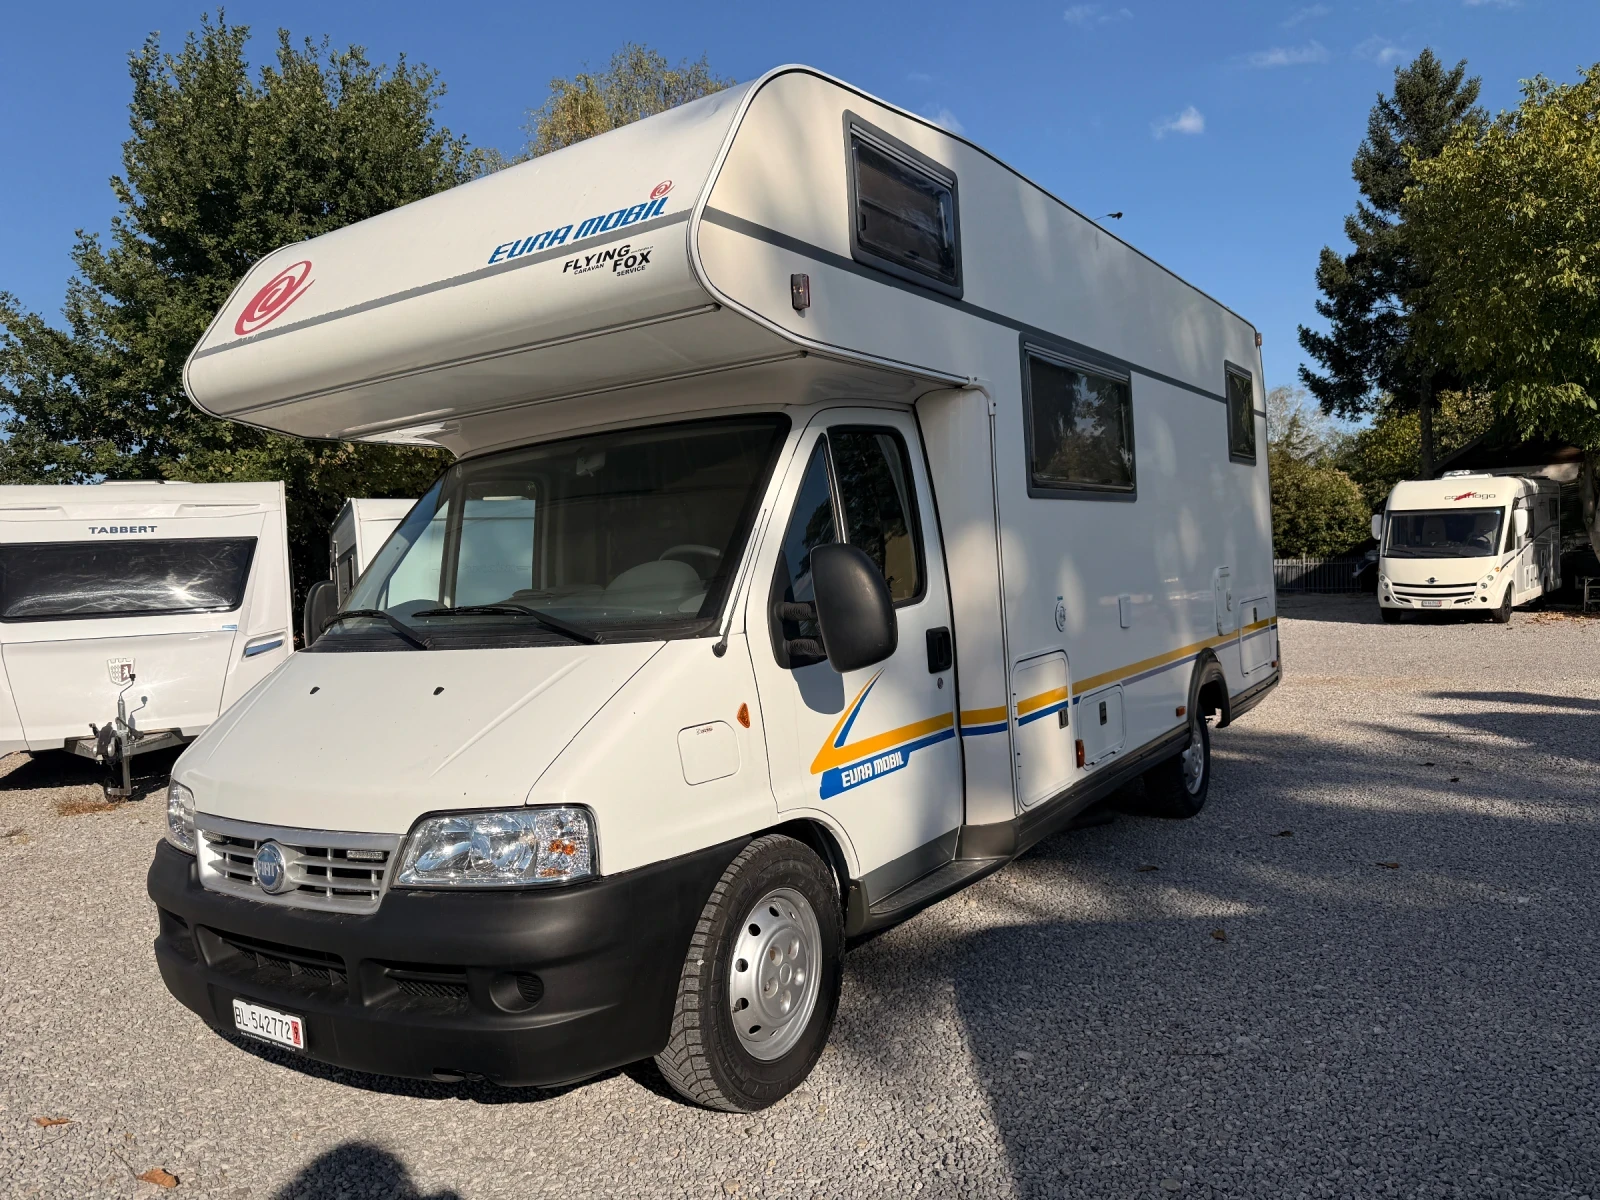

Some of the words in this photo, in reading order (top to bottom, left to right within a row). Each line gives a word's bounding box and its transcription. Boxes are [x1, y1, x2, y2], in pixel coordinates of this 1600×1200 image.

[488, 224, 574, 264] EURA
[573, 196, 669, 240] MOBIL
[562, 244, 631, 273] FLYING
[612, 250, 652, 272] FOX
[574, 263, 605, 275] CARAVAN
[616, 265, 646, 277] SERVICE
[88, 525, 158, 534] TABBERT
[841, 762, 873, 788] EURA
[873, 751, 905, 775] MOBIL
[257, 860, 276, 878] FIAT
